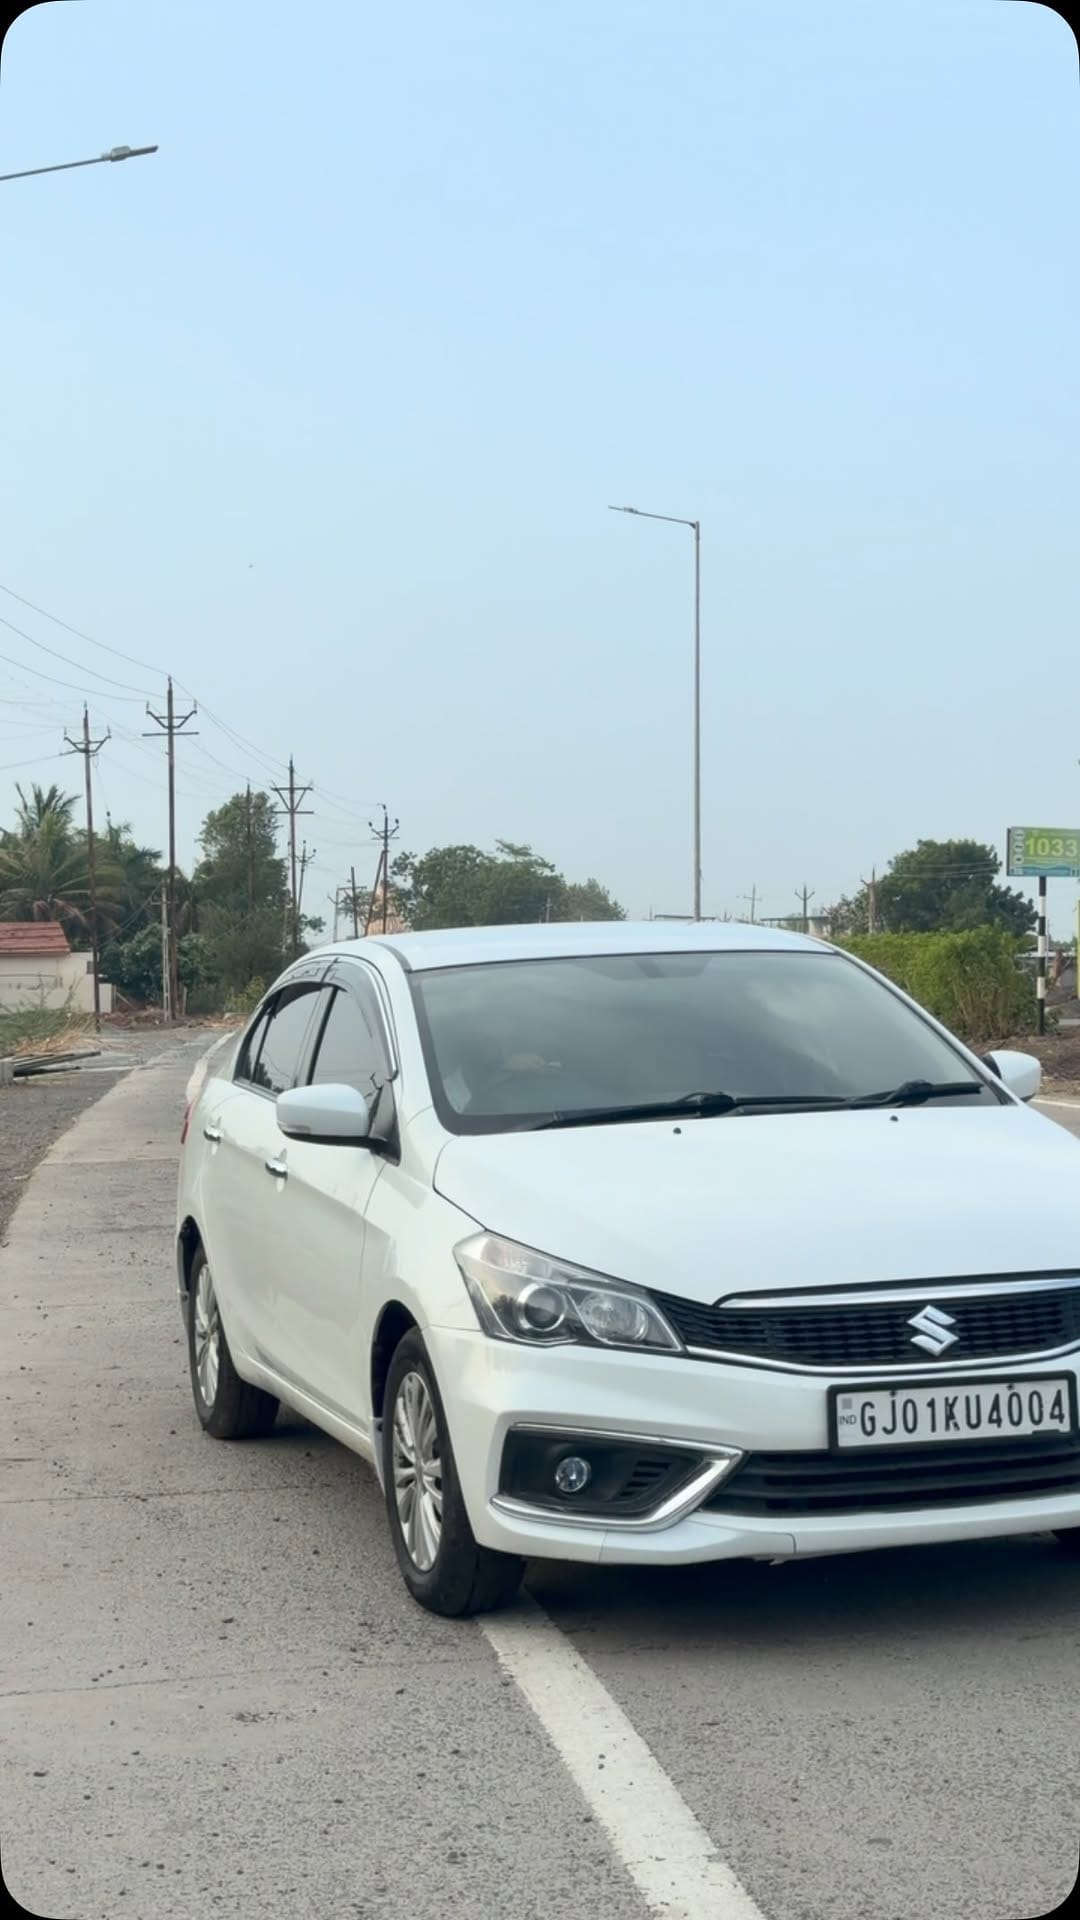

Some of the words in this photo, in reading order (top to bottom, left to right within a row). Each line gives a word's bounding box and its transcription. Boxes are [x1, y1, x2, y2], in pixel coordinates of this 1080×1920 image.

[1025, 837, 1078, 857] 1033
[838, 1414, 857, 1425] IND
[860, 1388, 1065, 1437] GJ01KU4004
